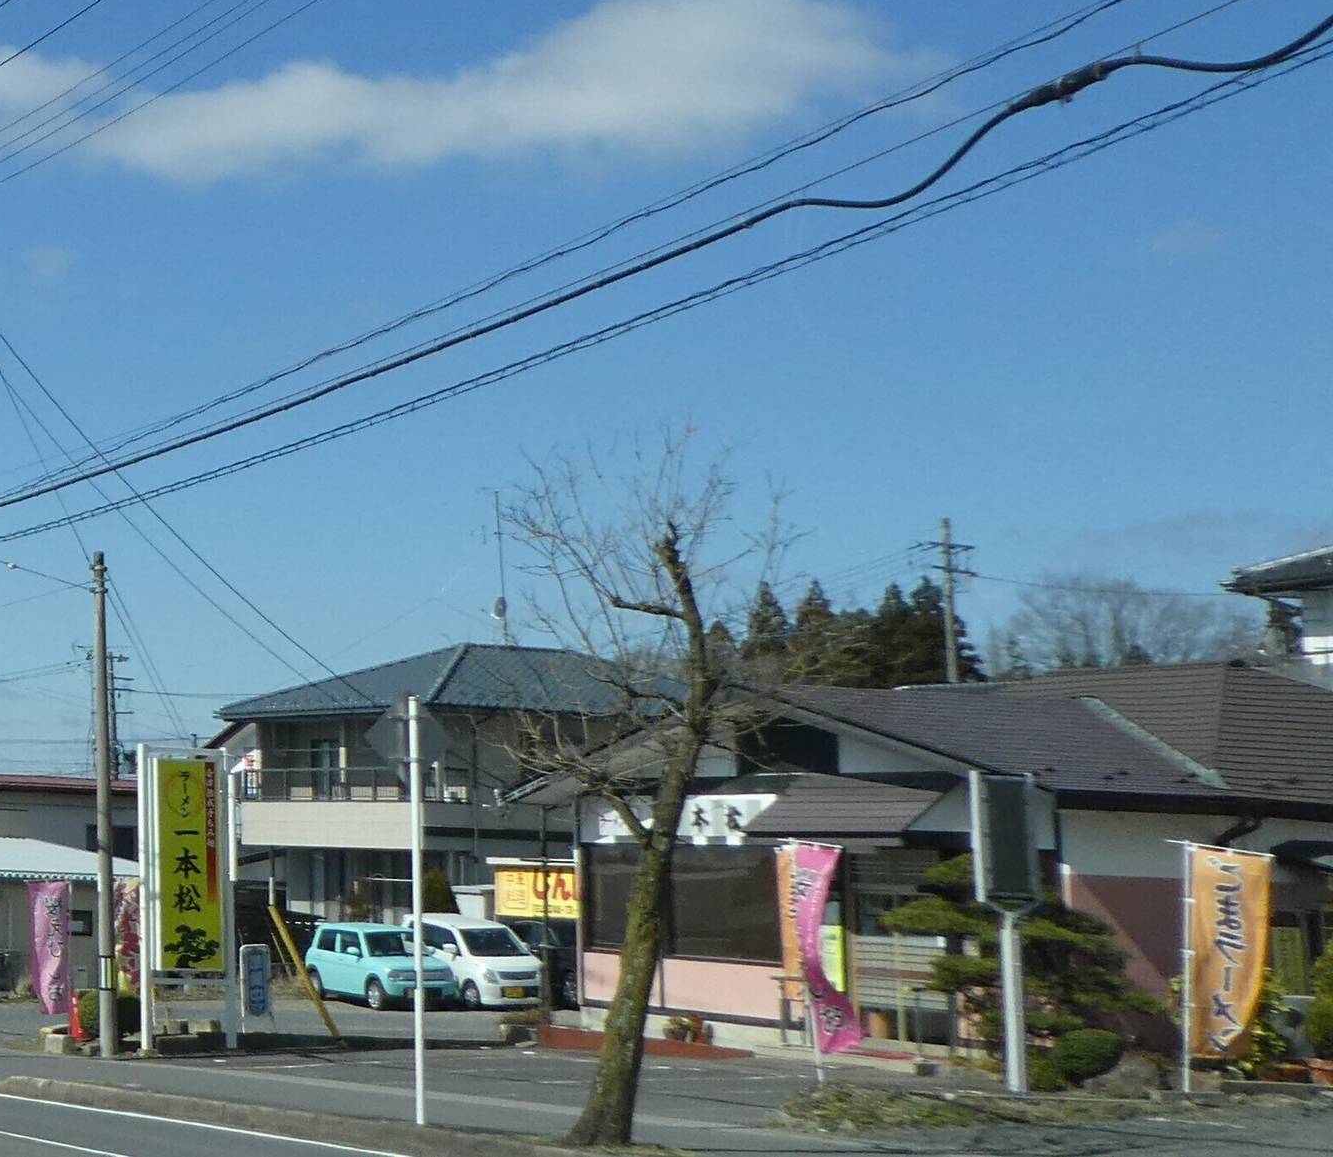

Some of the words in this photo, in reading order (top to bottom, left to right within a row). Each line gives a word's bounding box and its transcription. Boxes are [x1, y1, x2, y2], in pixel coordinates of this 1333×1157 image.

[180, 771, 191, 818] ラーメン
[173, 829, 202, 913] 一本松
